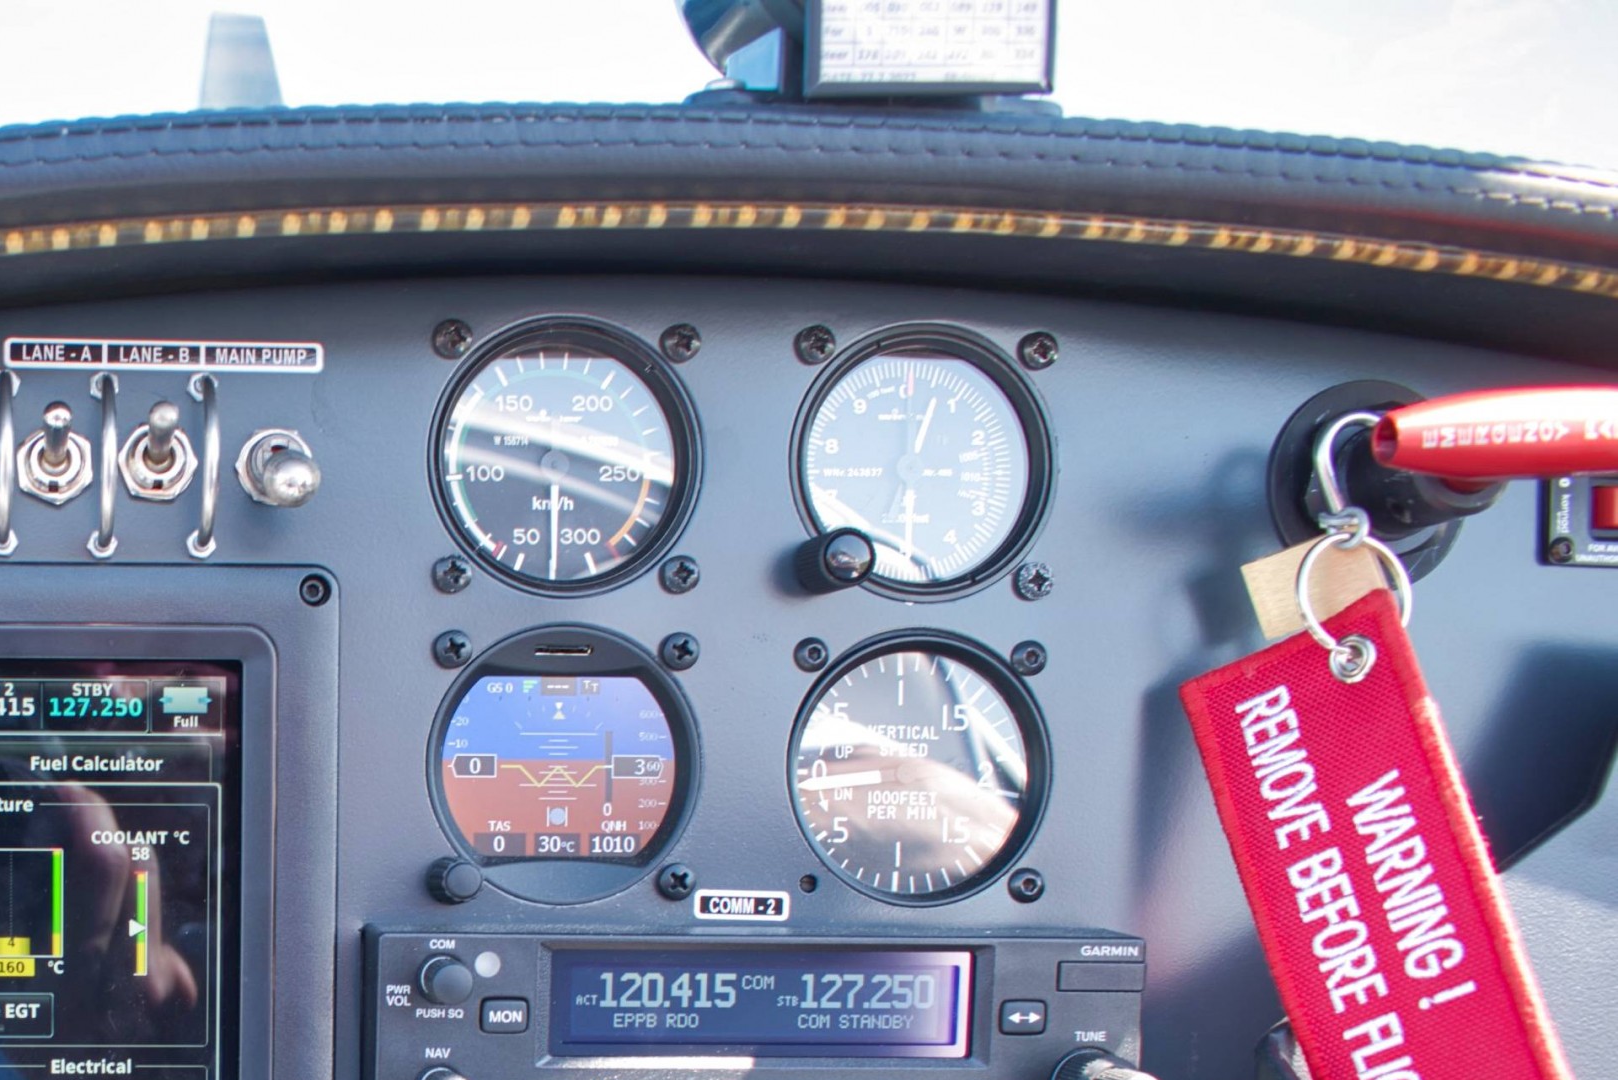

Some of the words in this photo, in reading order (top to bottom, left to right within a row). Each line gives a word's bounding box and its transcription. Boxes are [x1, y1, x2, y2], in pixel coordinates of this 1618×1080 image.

[21, 344, 65, 362] LANE
[80, 345, 93, 362] A
[119, 346, 163, 363] LANE
[179, 347, 190, 363] B
[215, 347, 256, 364] MAIN
[262, 348, 307, 365] PUMP
[495, 394, 533, 412] 150
[571, 394, 614, 412] 200
[465, 465, 505, 482] 100
[512, 528, 540, 545] 50
[559, 528, 601, 545] 300
[71, 683, 113, 698] STBY
[48, 697, 143, 718] 127.250
[879, 743, 929, 757] SPEED
[30, 756, 69, 772] Fuel
[73, 755, 164, 772] Calculator
[487, 821, 512, 831] TAS
[600, 821, 627, 832] QNH
[591, 836, 635, 853] 1010
[1235, 684, 1331, 850] REMOVE
[1286, 846, 1388, 1013] BEFORE
[1346, 769, 1465, 978] WARNING
[1080, 945, 1139, 957] GARMIN
[575, 994, 598, 1007] ACT
[598, 972, 737, 1009] 120.415
[741, 975, 775, 990] COM
[776, 995, 799, 1008] STB
[799, 973, 935, 1010] 127.250
[4, 1003, 40, 1020] EGT
[488, 1010, 523, 1024] MON
[797, 1014, 831, 1029] COM
[838, 1014, 914, 1030] STANDBY
[424, 1047, 451, 1059] NAV
[50, 1058, 132, 1075] Electrical
